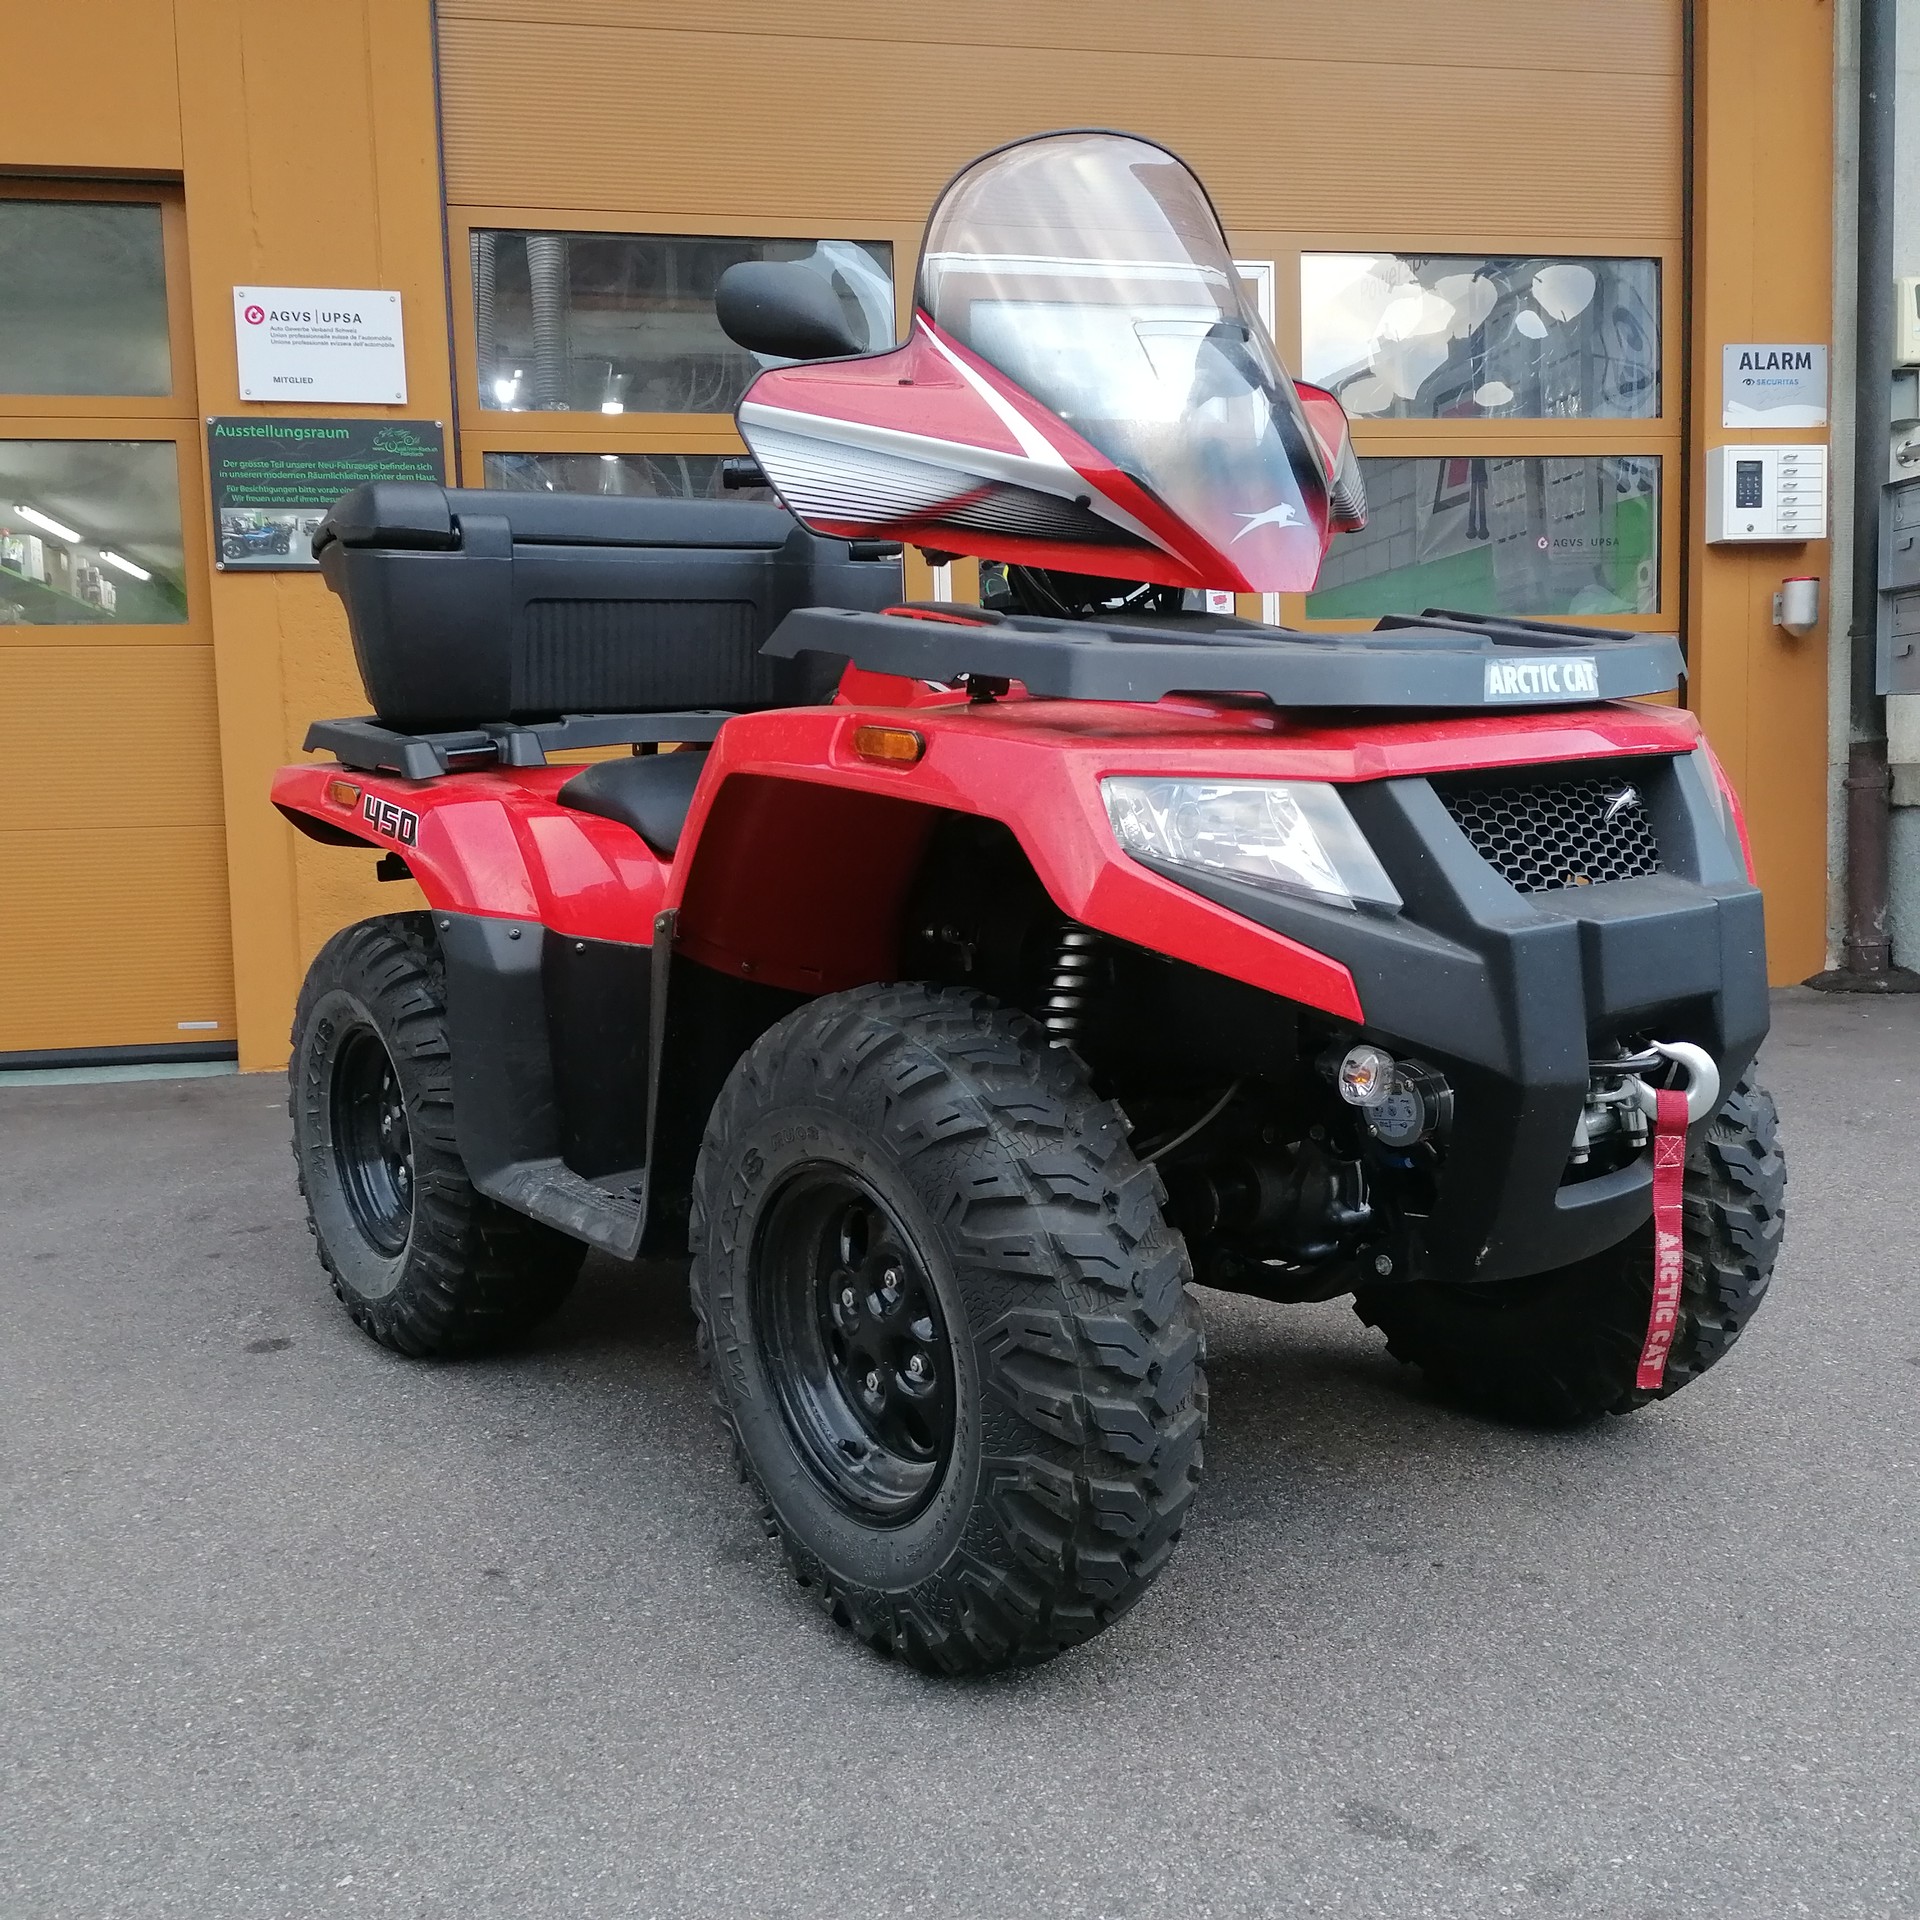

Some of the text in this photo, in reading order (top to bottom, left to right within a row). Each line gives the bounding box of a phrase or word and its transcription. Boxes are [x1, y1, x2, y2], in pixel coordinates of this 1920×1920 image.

[269, 311, 362, 324] AGVS UPSA
[1739, 352, 1812, 370] ALARM
[273, 376, 314, 384] MITGLIED
[215, 425, 350, 441] Ausstellungsraum
[223, 460, 433, 471] Der grösste Teil unserer Neu-Fahrzeuge befinden sich
[263, 471, 306, 479] modernen
[307, 471, 369, 480] Räumlichkeiten
[415, 473, 438, 481] Haus.
[240, 485, 298, 494] Besichtigungen
[317, 486, 339, 494] vorab
[1553, 538, 1620, 547] AGVS UPSA
[1490, 662, 1595, 694] ARCTIC CAT
[363, 793, 419, 849] 450
[1642, 1231, 1680, 1371] ARCTIC CAT
